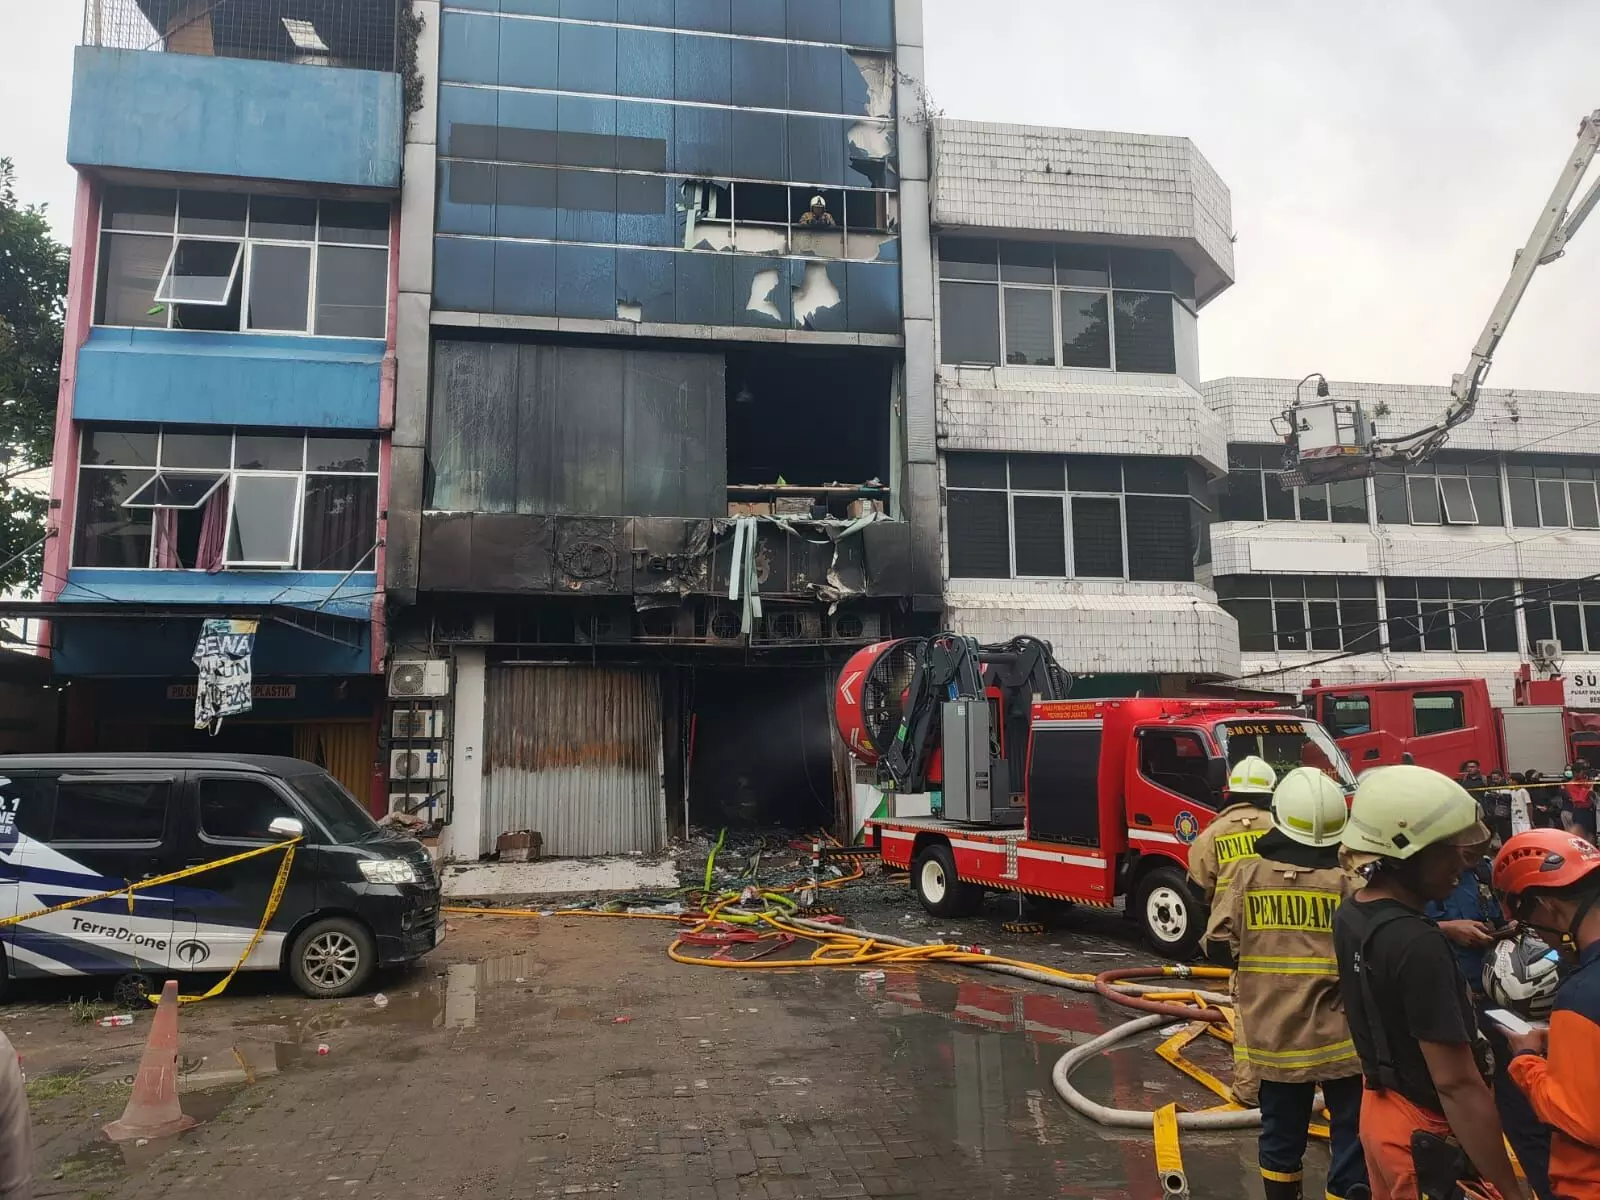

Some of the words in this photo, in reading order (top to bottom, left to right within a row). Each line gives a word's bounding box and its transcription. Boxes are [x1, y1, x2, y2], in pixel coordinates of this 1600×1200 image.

[195, 635, 251, 657] SEWA
[255, 686, 291, 697] PLASTIK
[1227, 724, 1271, 736] SMOKE
[12, 798, 20, 811] 1
[1247, 895, 1337, 929] PEMADAM
[71, 917, 167, 951] TerraDrone
